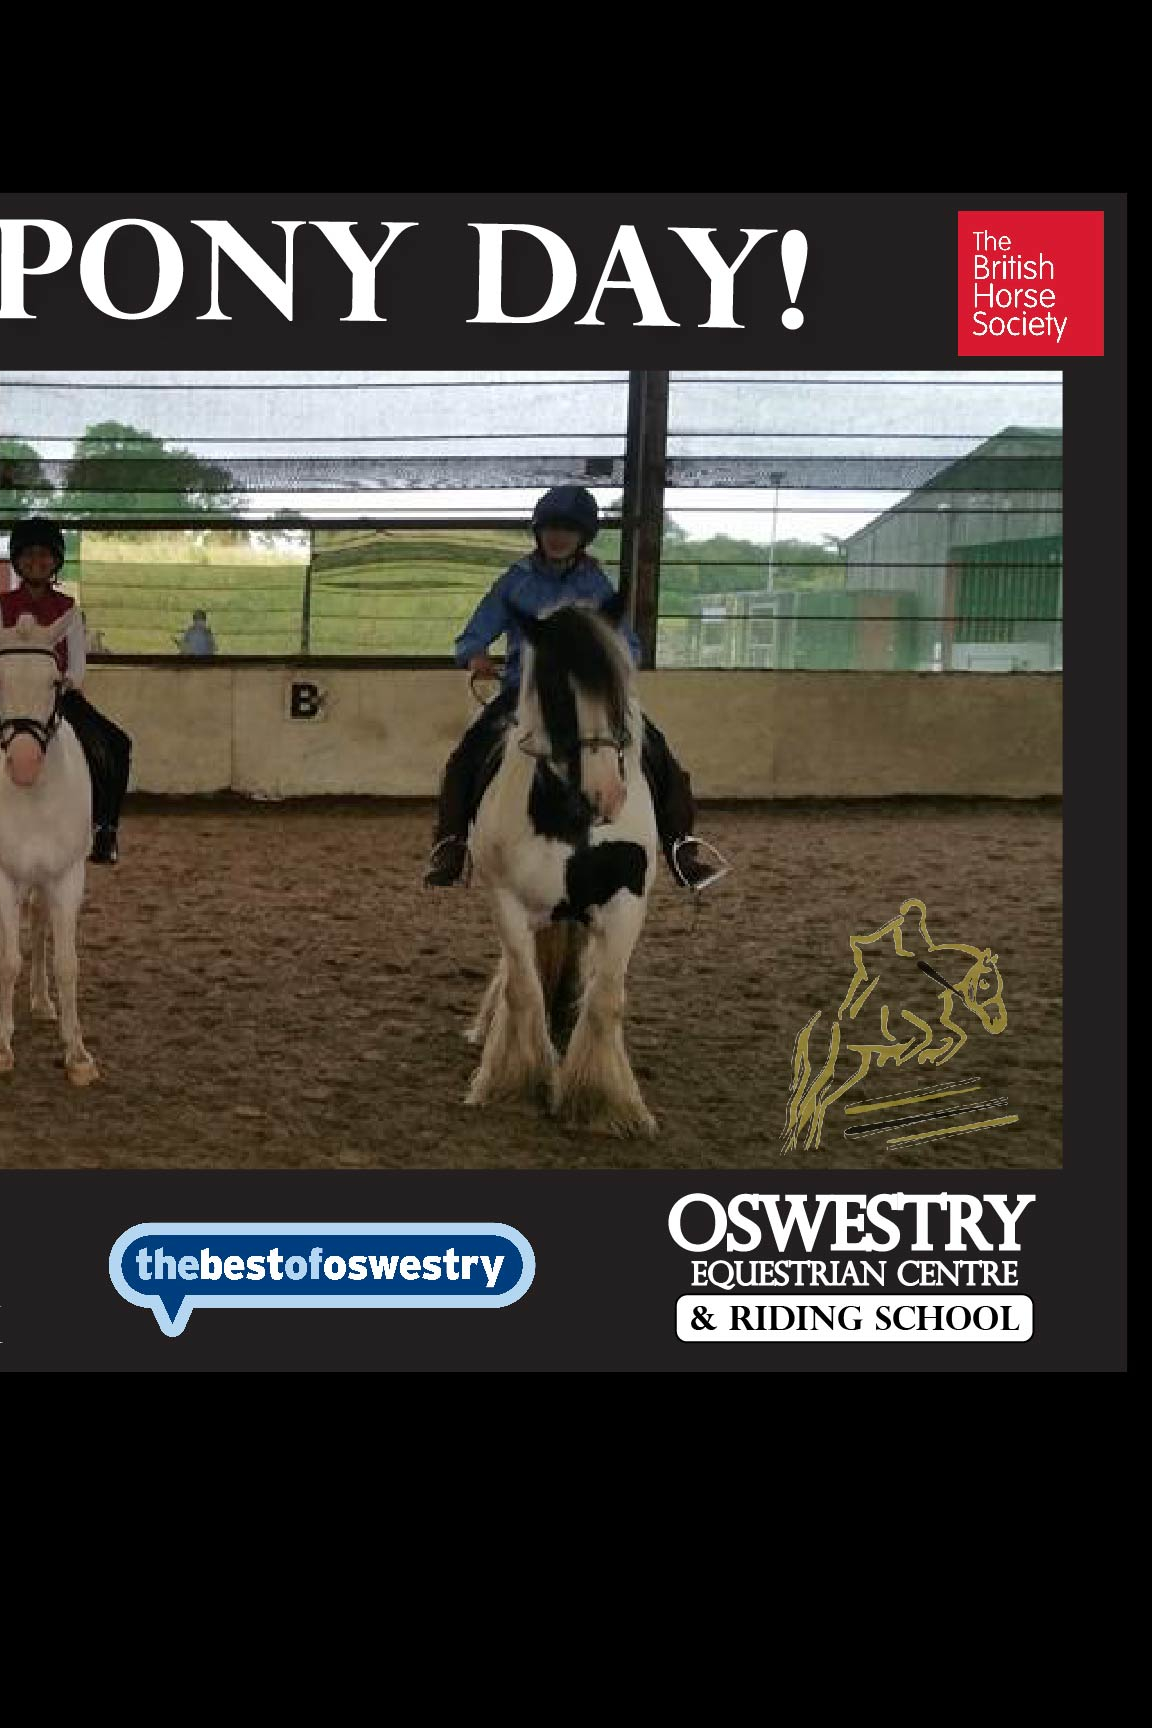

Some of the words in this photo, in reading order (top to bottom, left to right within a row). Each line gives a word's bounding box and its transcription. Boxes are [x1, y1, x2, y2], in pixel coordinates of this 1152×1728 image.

[973, 230, 1011, 251] The
[466, 223, 808, 330] DAY!
[975, 253, 1053, 280] British
[975, 283, 1056, 308] Horse
[973, 310, 1068, 343] Society
[291, 682, 318, 719] B
[668, 1192, 1036, 1252] OSWESTRY
[136, 1246, 506, 1288] thebestofoswestry
[691, 1260, 888, 1290] EQUESTRIAN
[896, 1260, 1019, 1287] CENTRE
[690, 1305, 717, 1331] &
[729, 1305, 862, 1331] RIDING
[875, 1305, 1020, 1331] SCHOOL
